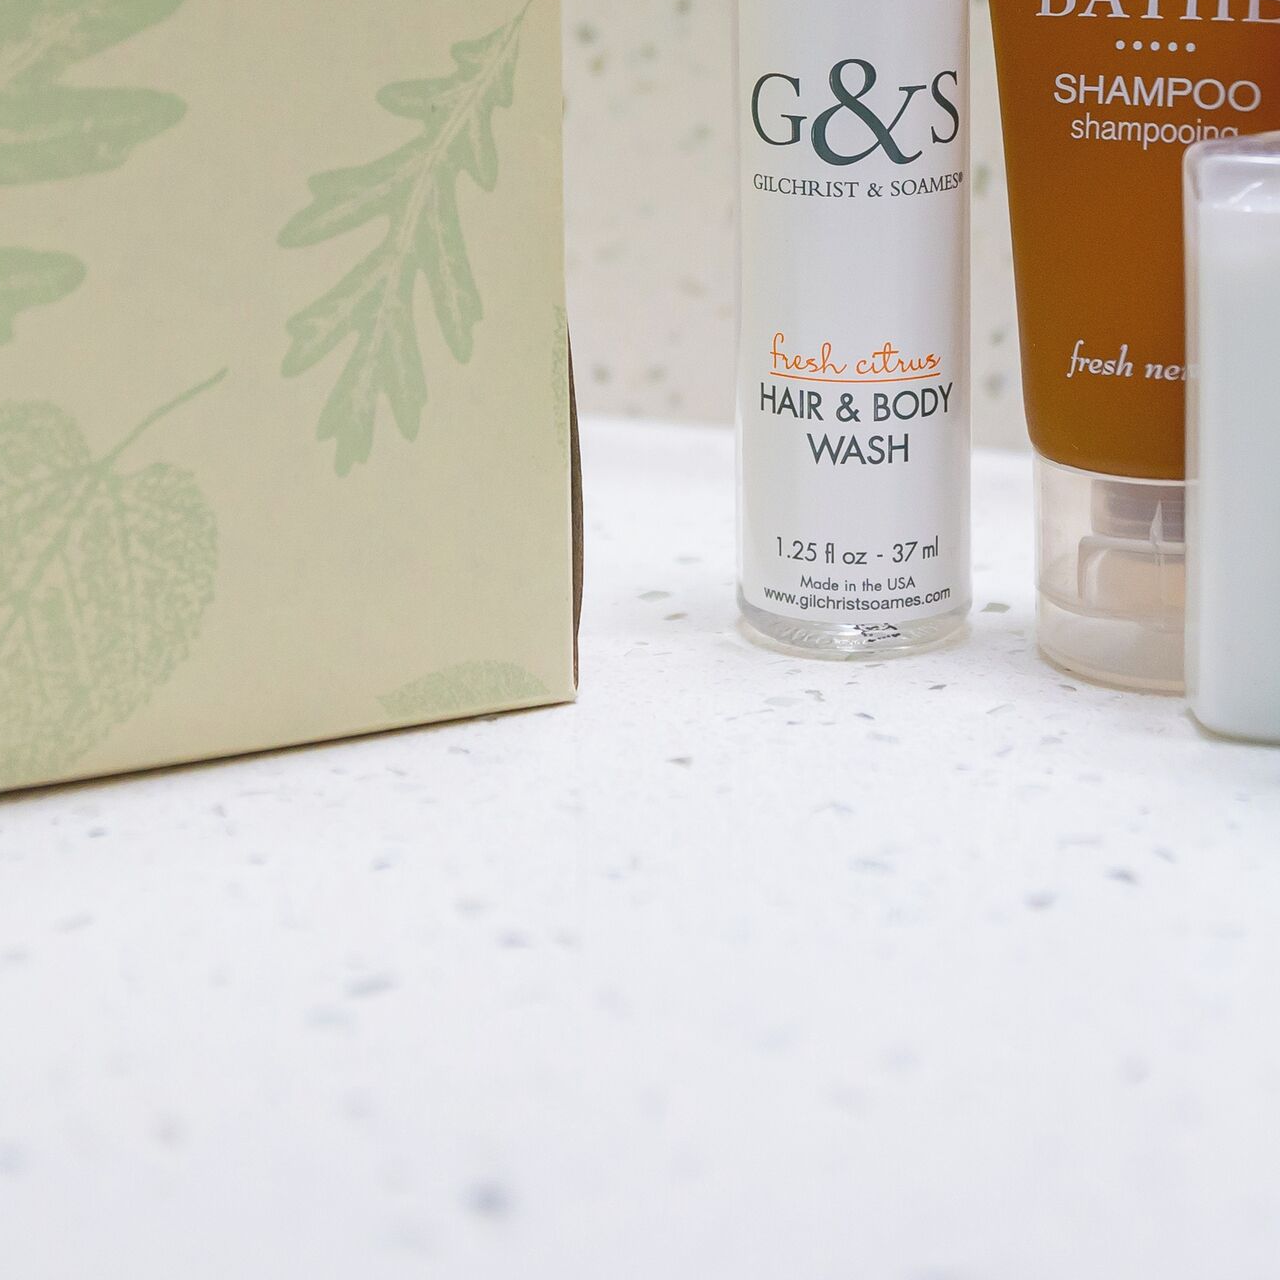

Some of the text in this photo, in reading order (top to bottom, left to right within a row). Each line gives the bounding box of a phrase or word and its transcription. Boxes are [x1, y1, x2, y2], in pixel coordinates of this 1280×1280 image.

[1053, 73, 1262, 112] SHAMPOO
[753, 173, 859, 198] GILCHRIST
[867, 182, 883, 198] &
[770, 332, 941, 375] fresh citrus
[1066, 339, 1134, 378] fresh
[760, 382, 953, 422] HAIR & BODY
[806, 433, 909, 466] WASH
[776, 536, 818, 562] 1.25
[825, 542, 835, 564] fl
[842, 551, 868, 565] oz
[892, 541, 918, 563] 37
[922, 535, 939, 560] ml
[764, 587, 951, 610] www.gilchristsoames.com
[800, 575, 916, 592] Made in the USA
